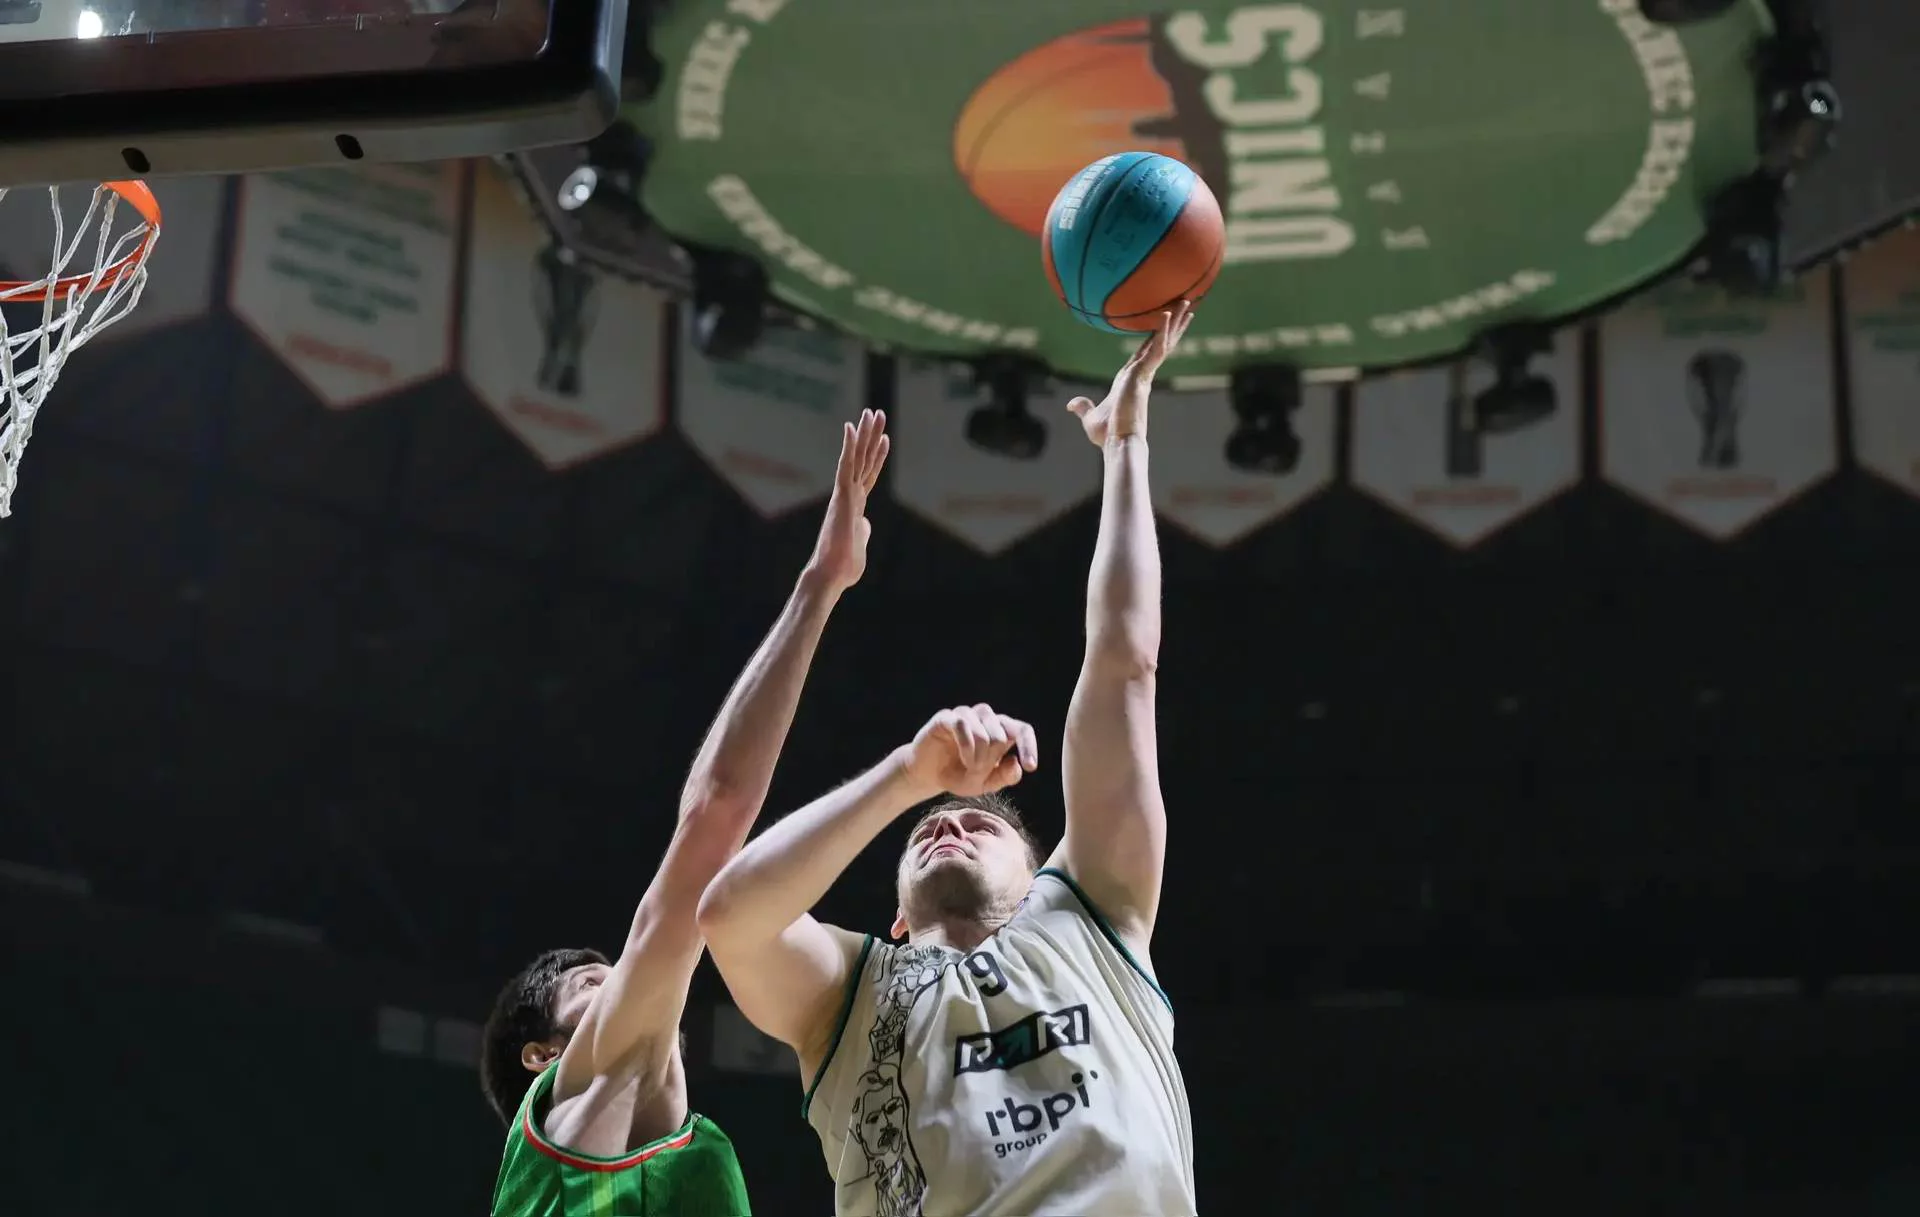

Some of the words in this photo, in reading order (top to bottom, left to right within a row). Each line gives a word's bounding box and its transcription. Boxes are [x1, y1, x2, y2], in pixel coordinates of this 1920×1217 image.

[1167, 4, 1356, 264] UNICS
[1352, 8, 1430, 250] KAZAN
[965, 951, 1008, 997] 9
[958, 1008, 1086, 1070] PARI
[995, 1132, 1048, 1158] group
